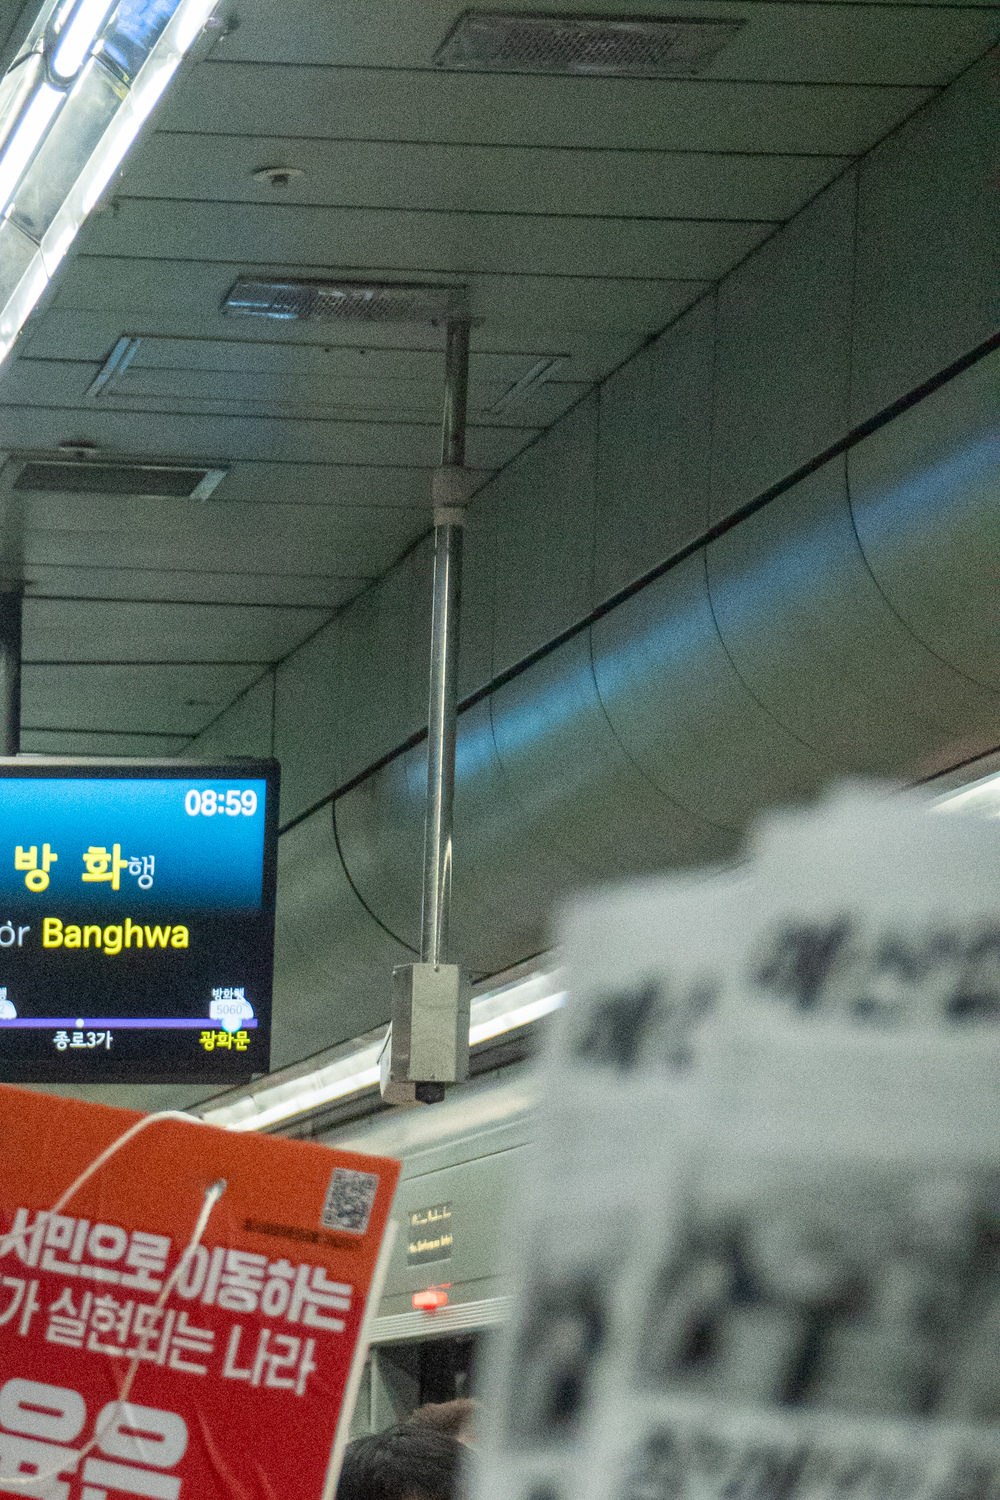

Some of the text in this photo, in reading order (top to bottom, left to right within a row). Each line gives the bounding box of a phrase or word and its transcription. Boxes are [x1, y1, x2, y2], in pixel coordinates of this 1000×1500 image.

[185, 789, 257, 816] 08:59
[15, 844, 57, 892] 방
[43, 917, 189, 954] Banghwa
[212, 987, 245, 1000] 방화행
[216, 1004, 243, 1015] 5060
[53, 1031, 113, 1050] 종로3가
[199, 1030, 250, 1051] 광화문
[0, 1207, 172, 1294] 서민으로
[177, 1243, 354, 1332] 이동하는
[45, 1298, 215, 1376] 실현되는
[222, 1325, 318, 1397] 나라
